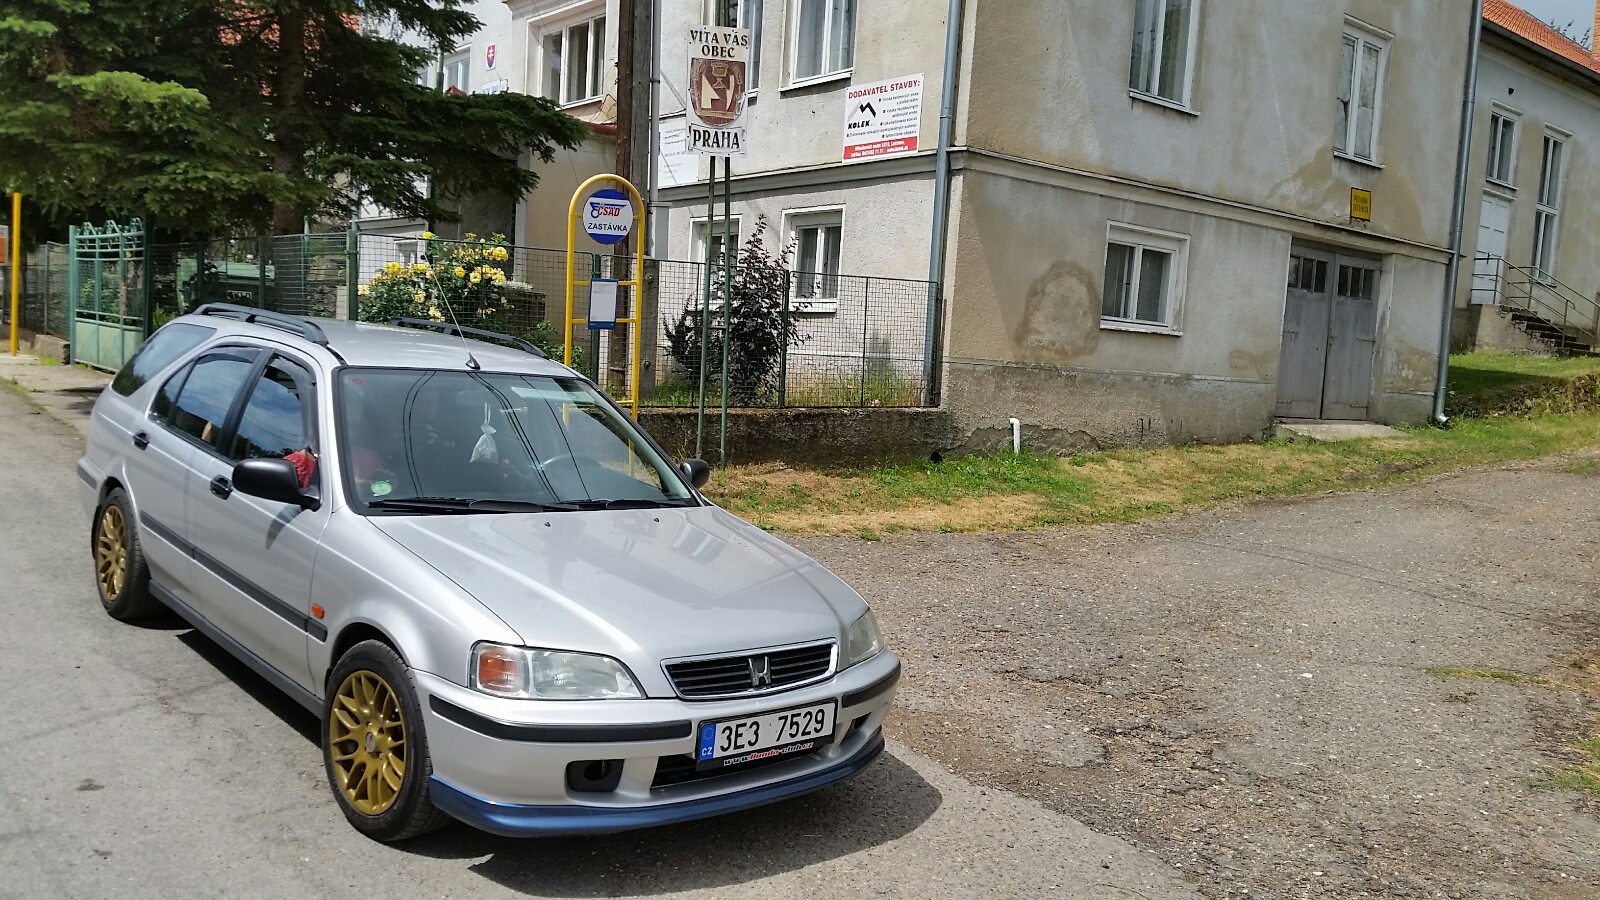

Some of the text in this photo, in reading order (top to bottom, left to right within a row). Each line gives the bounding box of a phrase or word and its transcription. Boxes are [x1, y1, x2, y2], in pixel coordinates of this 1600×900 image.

[701, 44, 736, 58] OBEC
[848, 120, 871, 130] KOLEK
[692, 129, 740, 149] PRAHA
[587, 222, 628, 232] ZASTÁVKA
[701, 708, 825, 756] CZ 3E3 7529
